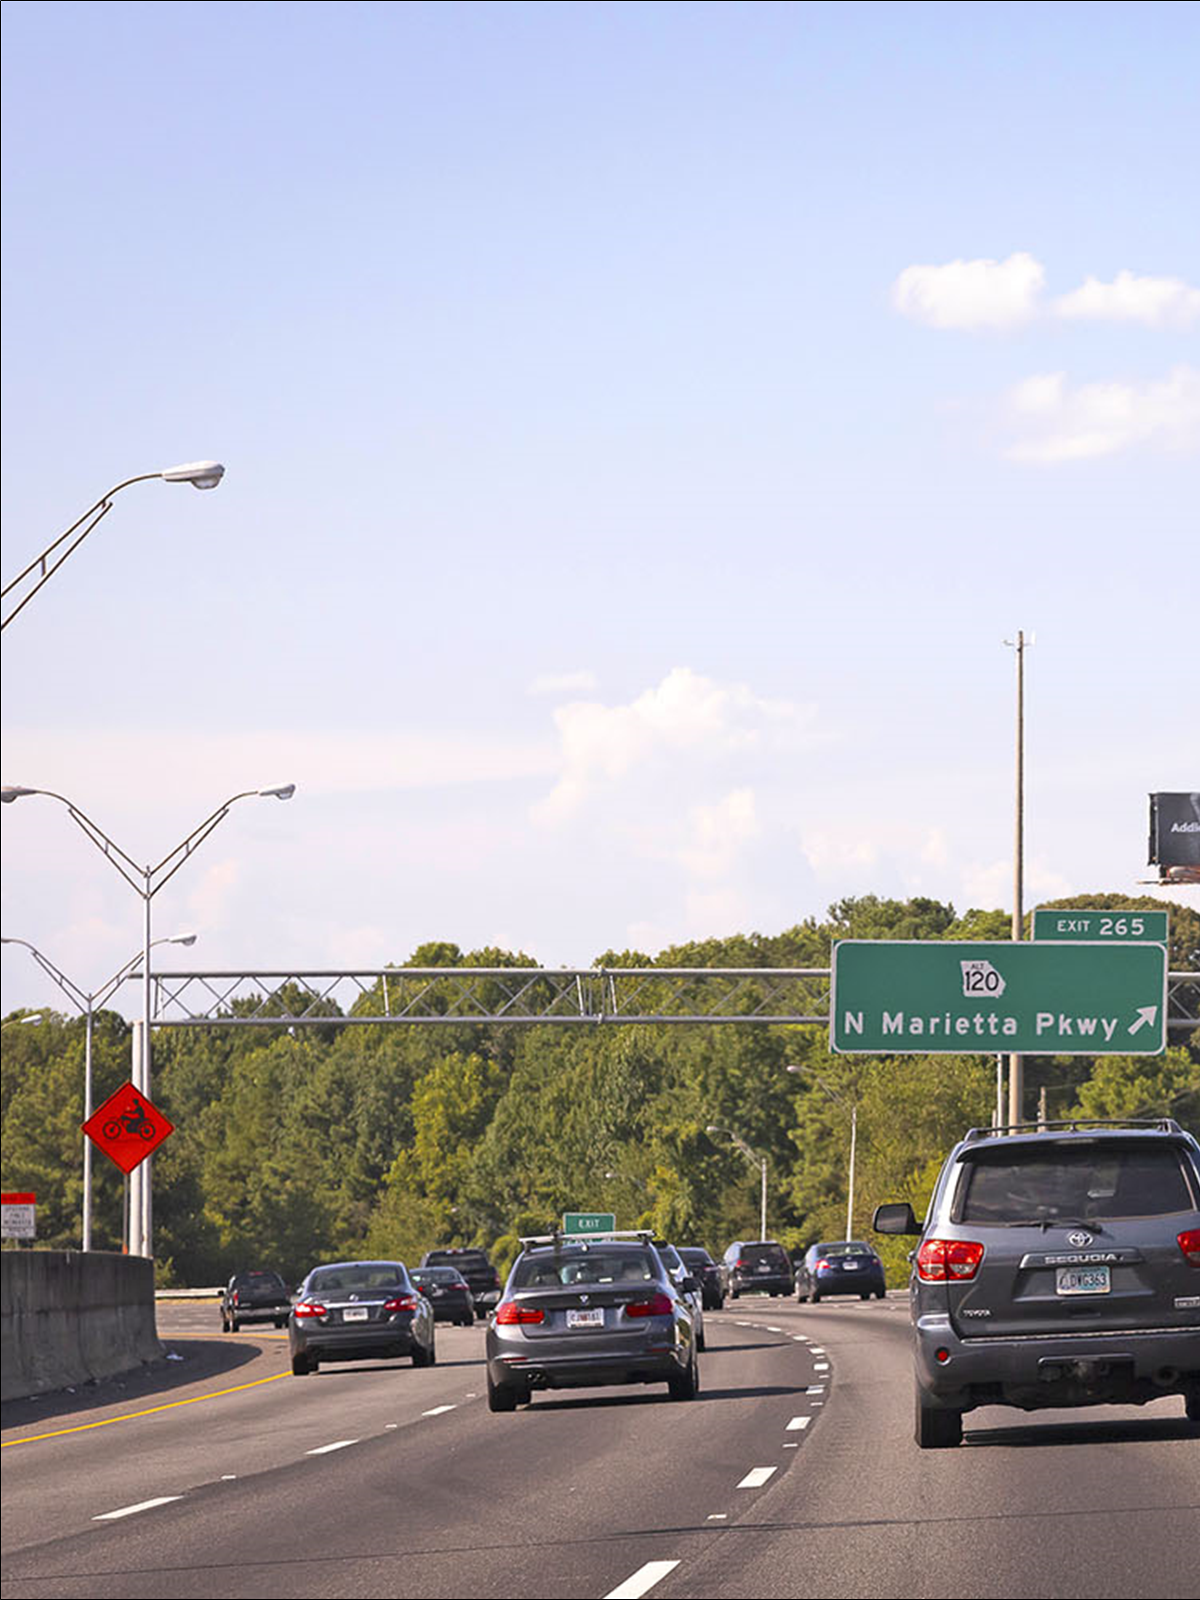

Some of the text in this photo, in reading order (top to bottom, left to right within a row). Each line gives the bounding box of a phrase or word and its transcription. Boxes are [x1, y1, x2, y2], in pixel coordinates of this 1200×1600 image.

[1057, 918, 1145, 936] EXIT 265
[965, 971, 999, 991] 120
[845, 1011, 1118, 1042] N Marietta Pkwy
[578, 1219, 601, 1229] EXIT
[1044, 1253, 1117, 1265] SEQUOIA
